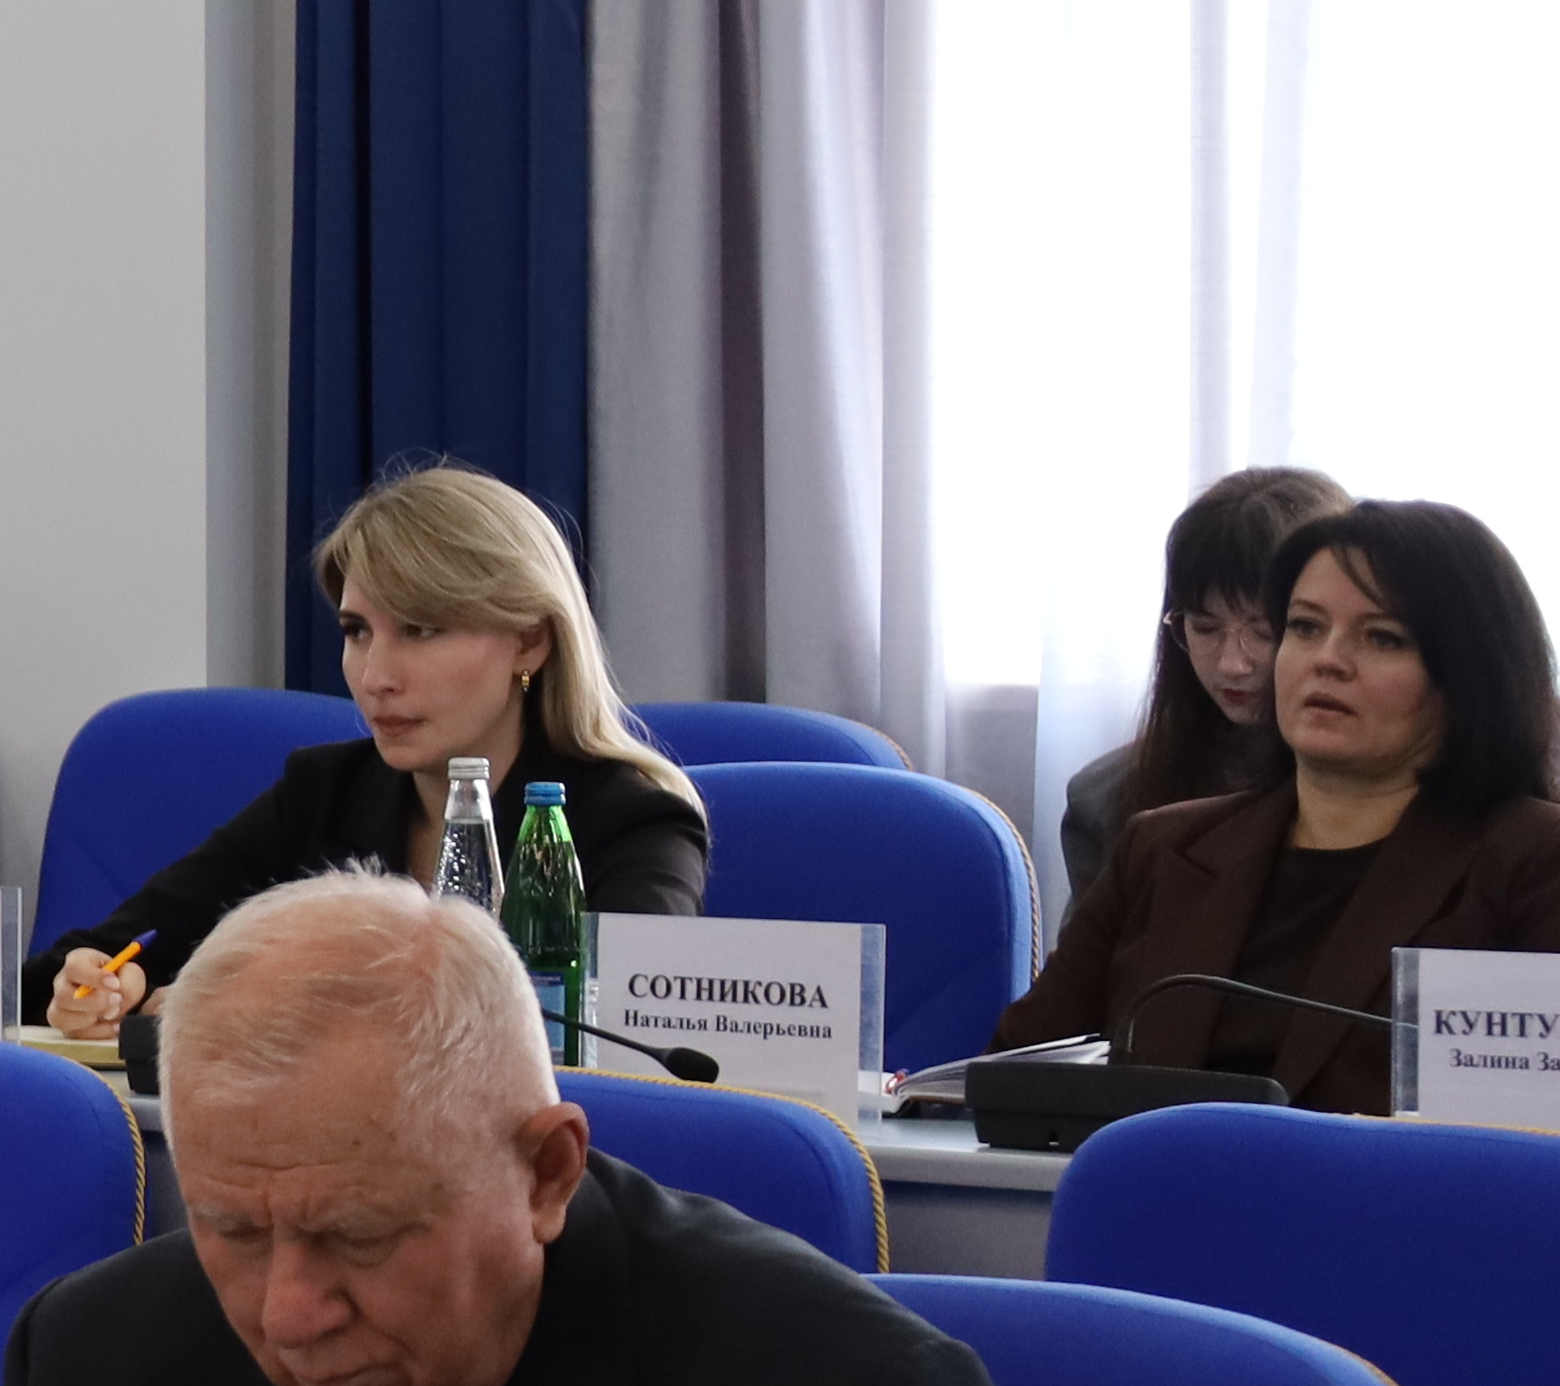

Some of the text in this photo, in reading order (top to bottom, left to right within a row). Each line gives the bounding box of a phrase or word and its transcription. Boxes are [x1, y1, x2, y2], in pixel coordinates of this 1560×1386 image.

[628, 972, 829, 1009] СОТНИКОВА
[624, 1009, 832, 1040] Наталья Валерьевна
[1433, 1009, 1560, 1039] КУНТУ
[1450, 1048, 1530, 1070] Залина
